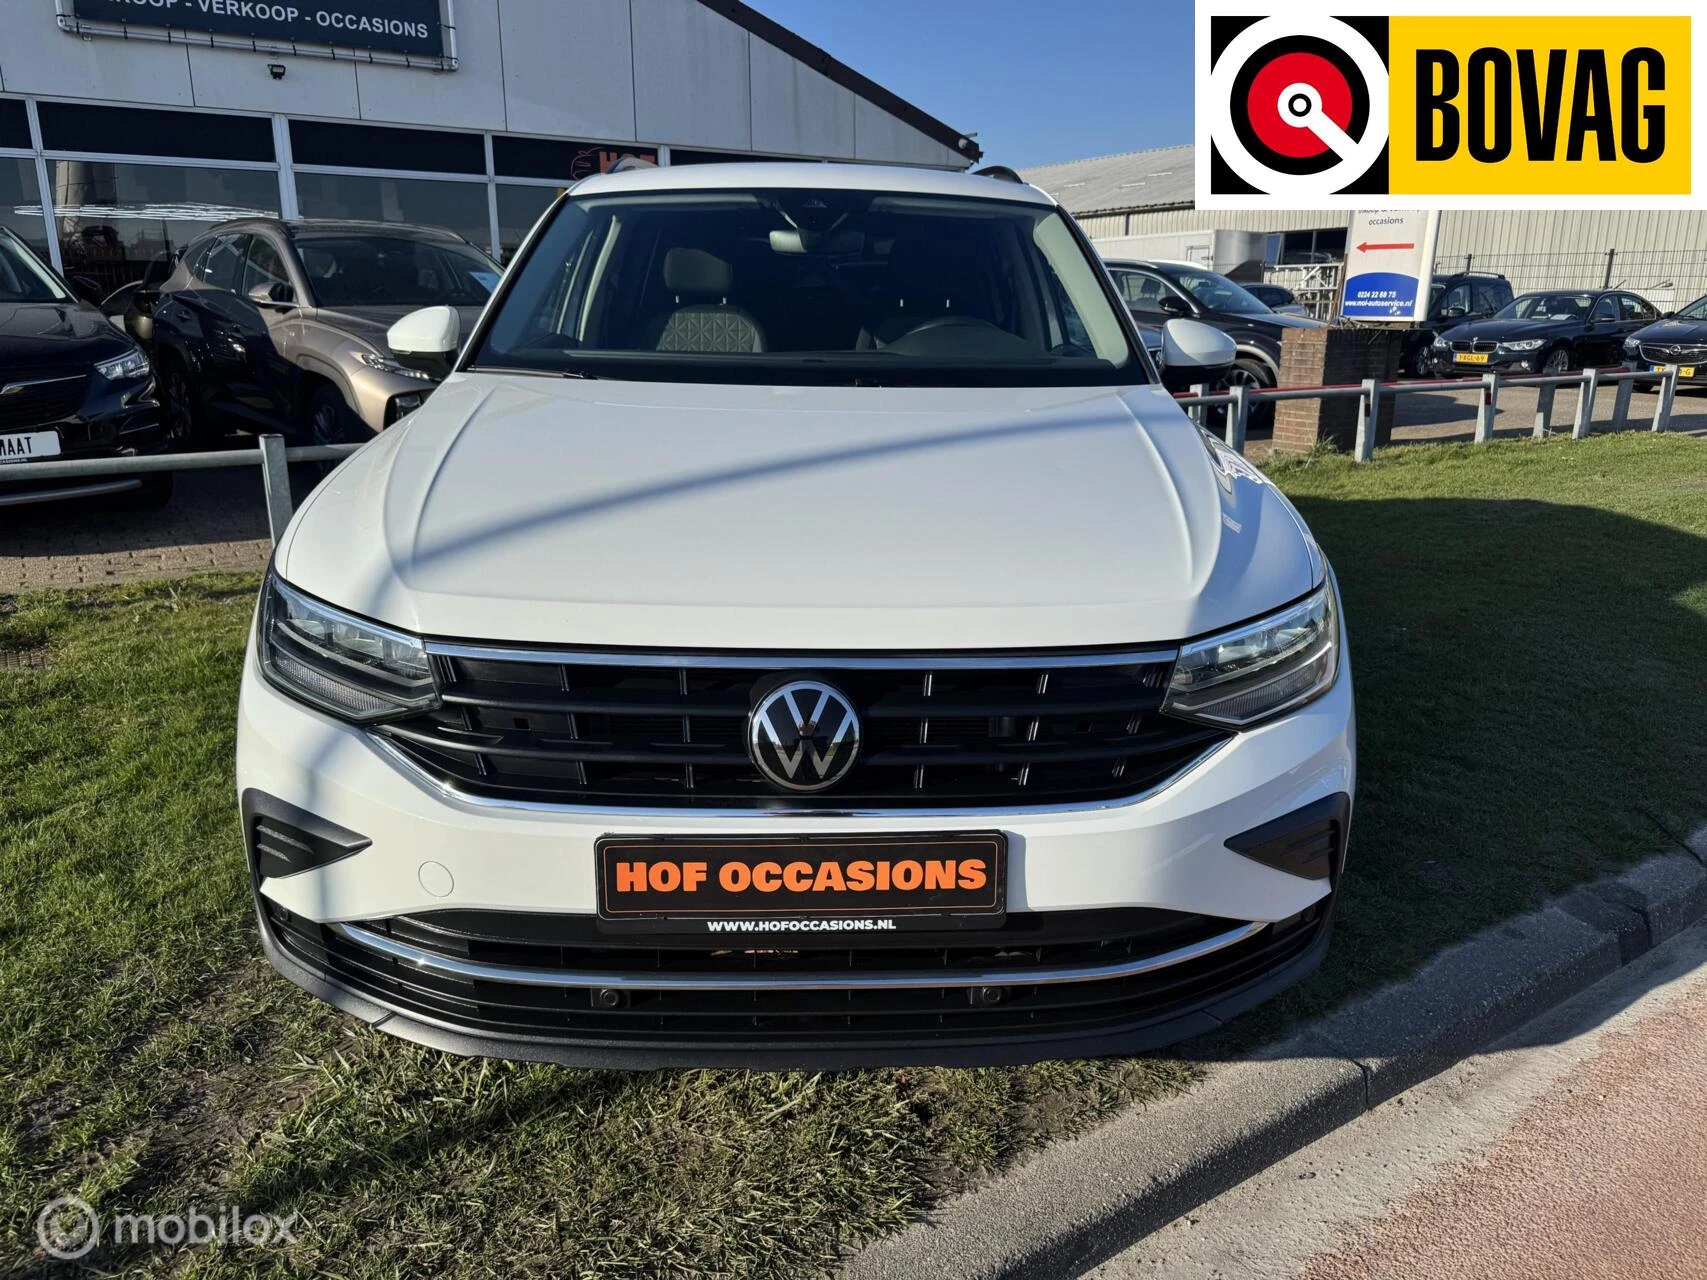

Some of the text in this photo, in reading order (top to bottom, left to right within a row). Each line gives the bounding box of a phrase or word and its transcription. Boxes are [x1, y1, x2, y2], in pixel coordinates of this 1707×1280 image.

[199, 0, 299, 22] VERKOOP
[316, 11, 428, 38] OCCASIONS
[1368, 216, 1404, 226] occasions
[616, 858, 987, 893] HOF OCCASIONS
[707, 919, 897, 932] WWW.HOFOCCASIONS.NL
